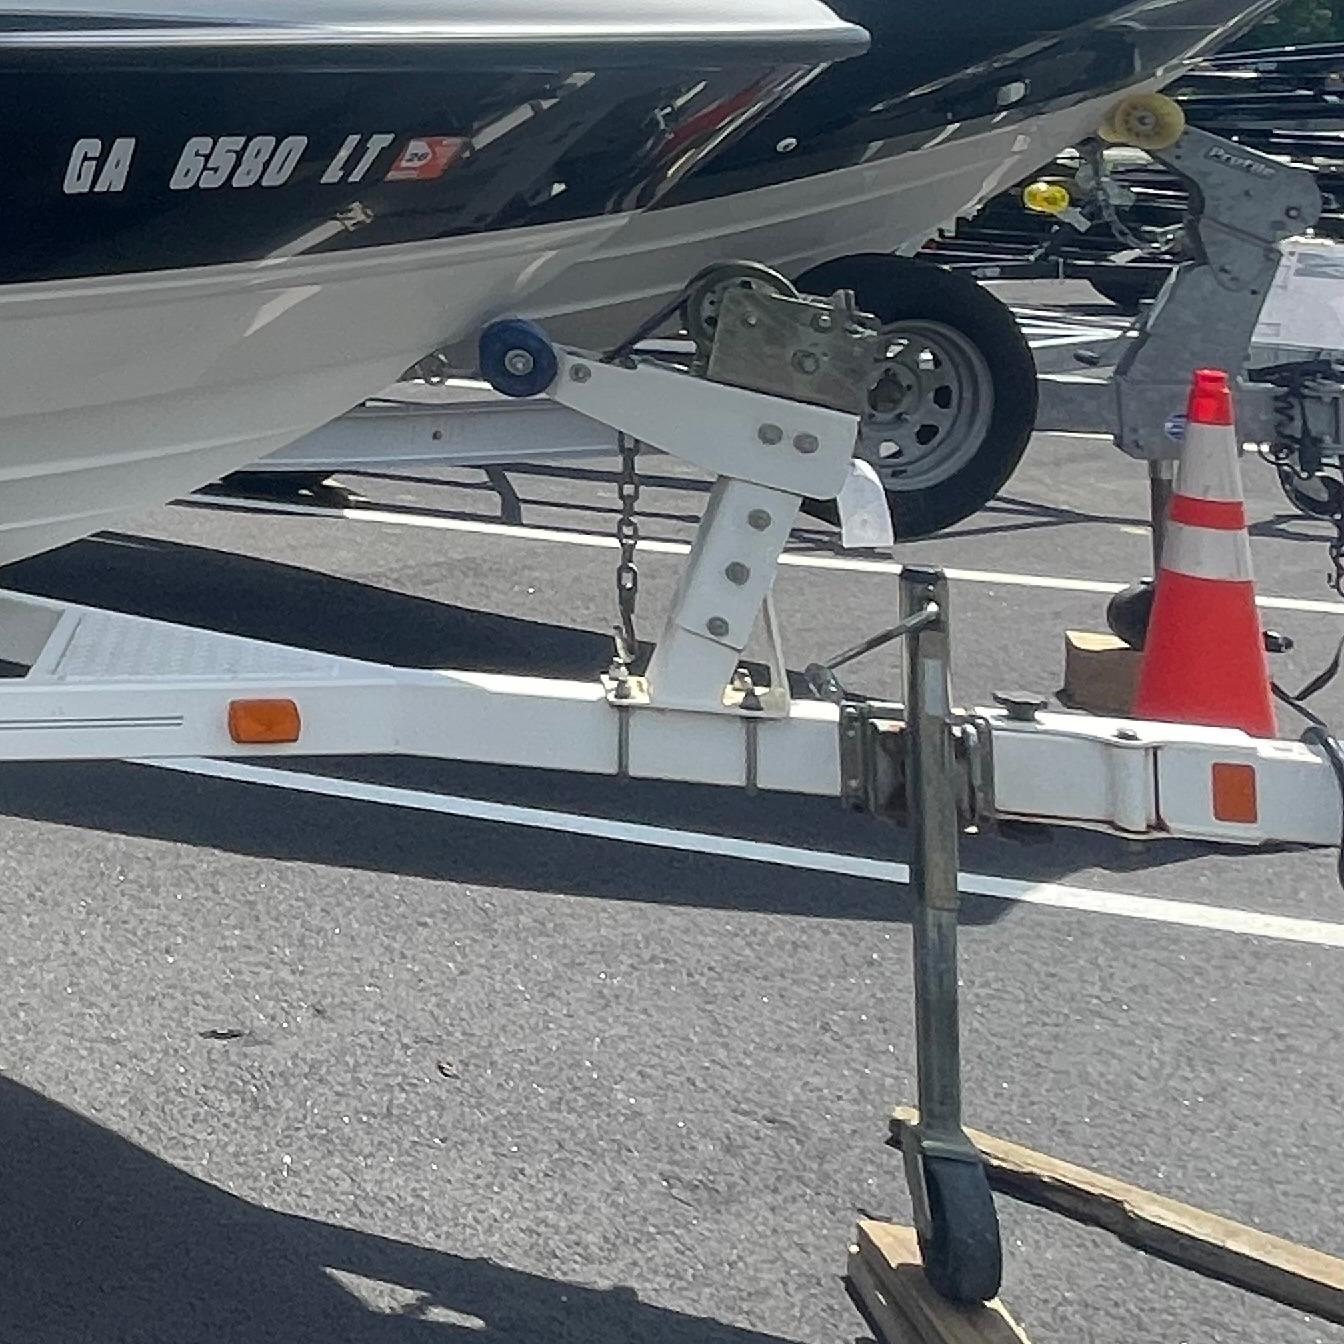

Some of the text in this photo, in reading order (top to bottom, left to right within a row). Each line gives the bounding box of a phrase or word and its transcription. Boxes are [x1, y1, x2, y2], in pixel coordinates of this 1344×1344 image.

[62, 133, 396, 194] GA 6580 LT
